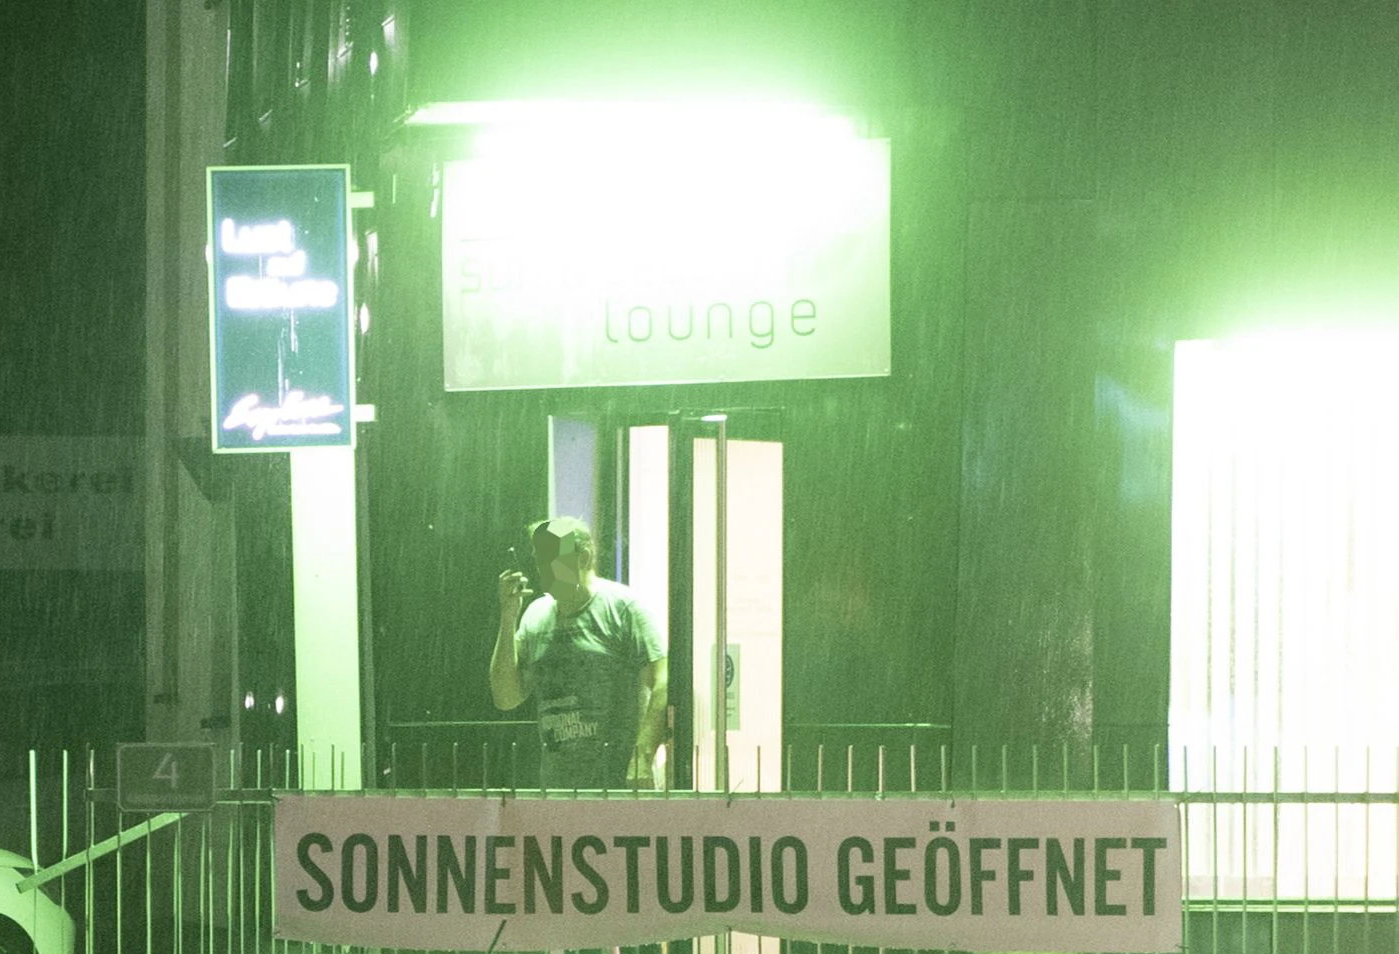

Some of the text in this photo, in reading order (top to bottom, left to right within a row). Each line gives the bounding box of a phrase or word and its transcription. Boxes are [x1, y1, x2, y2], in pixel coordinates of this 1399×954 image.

[604, 297, 818, 350] lounge
[152, 751, 180, 789] 4
[295, 821, 1168, 917] SONNENSTUDIO GEÖFFNET
